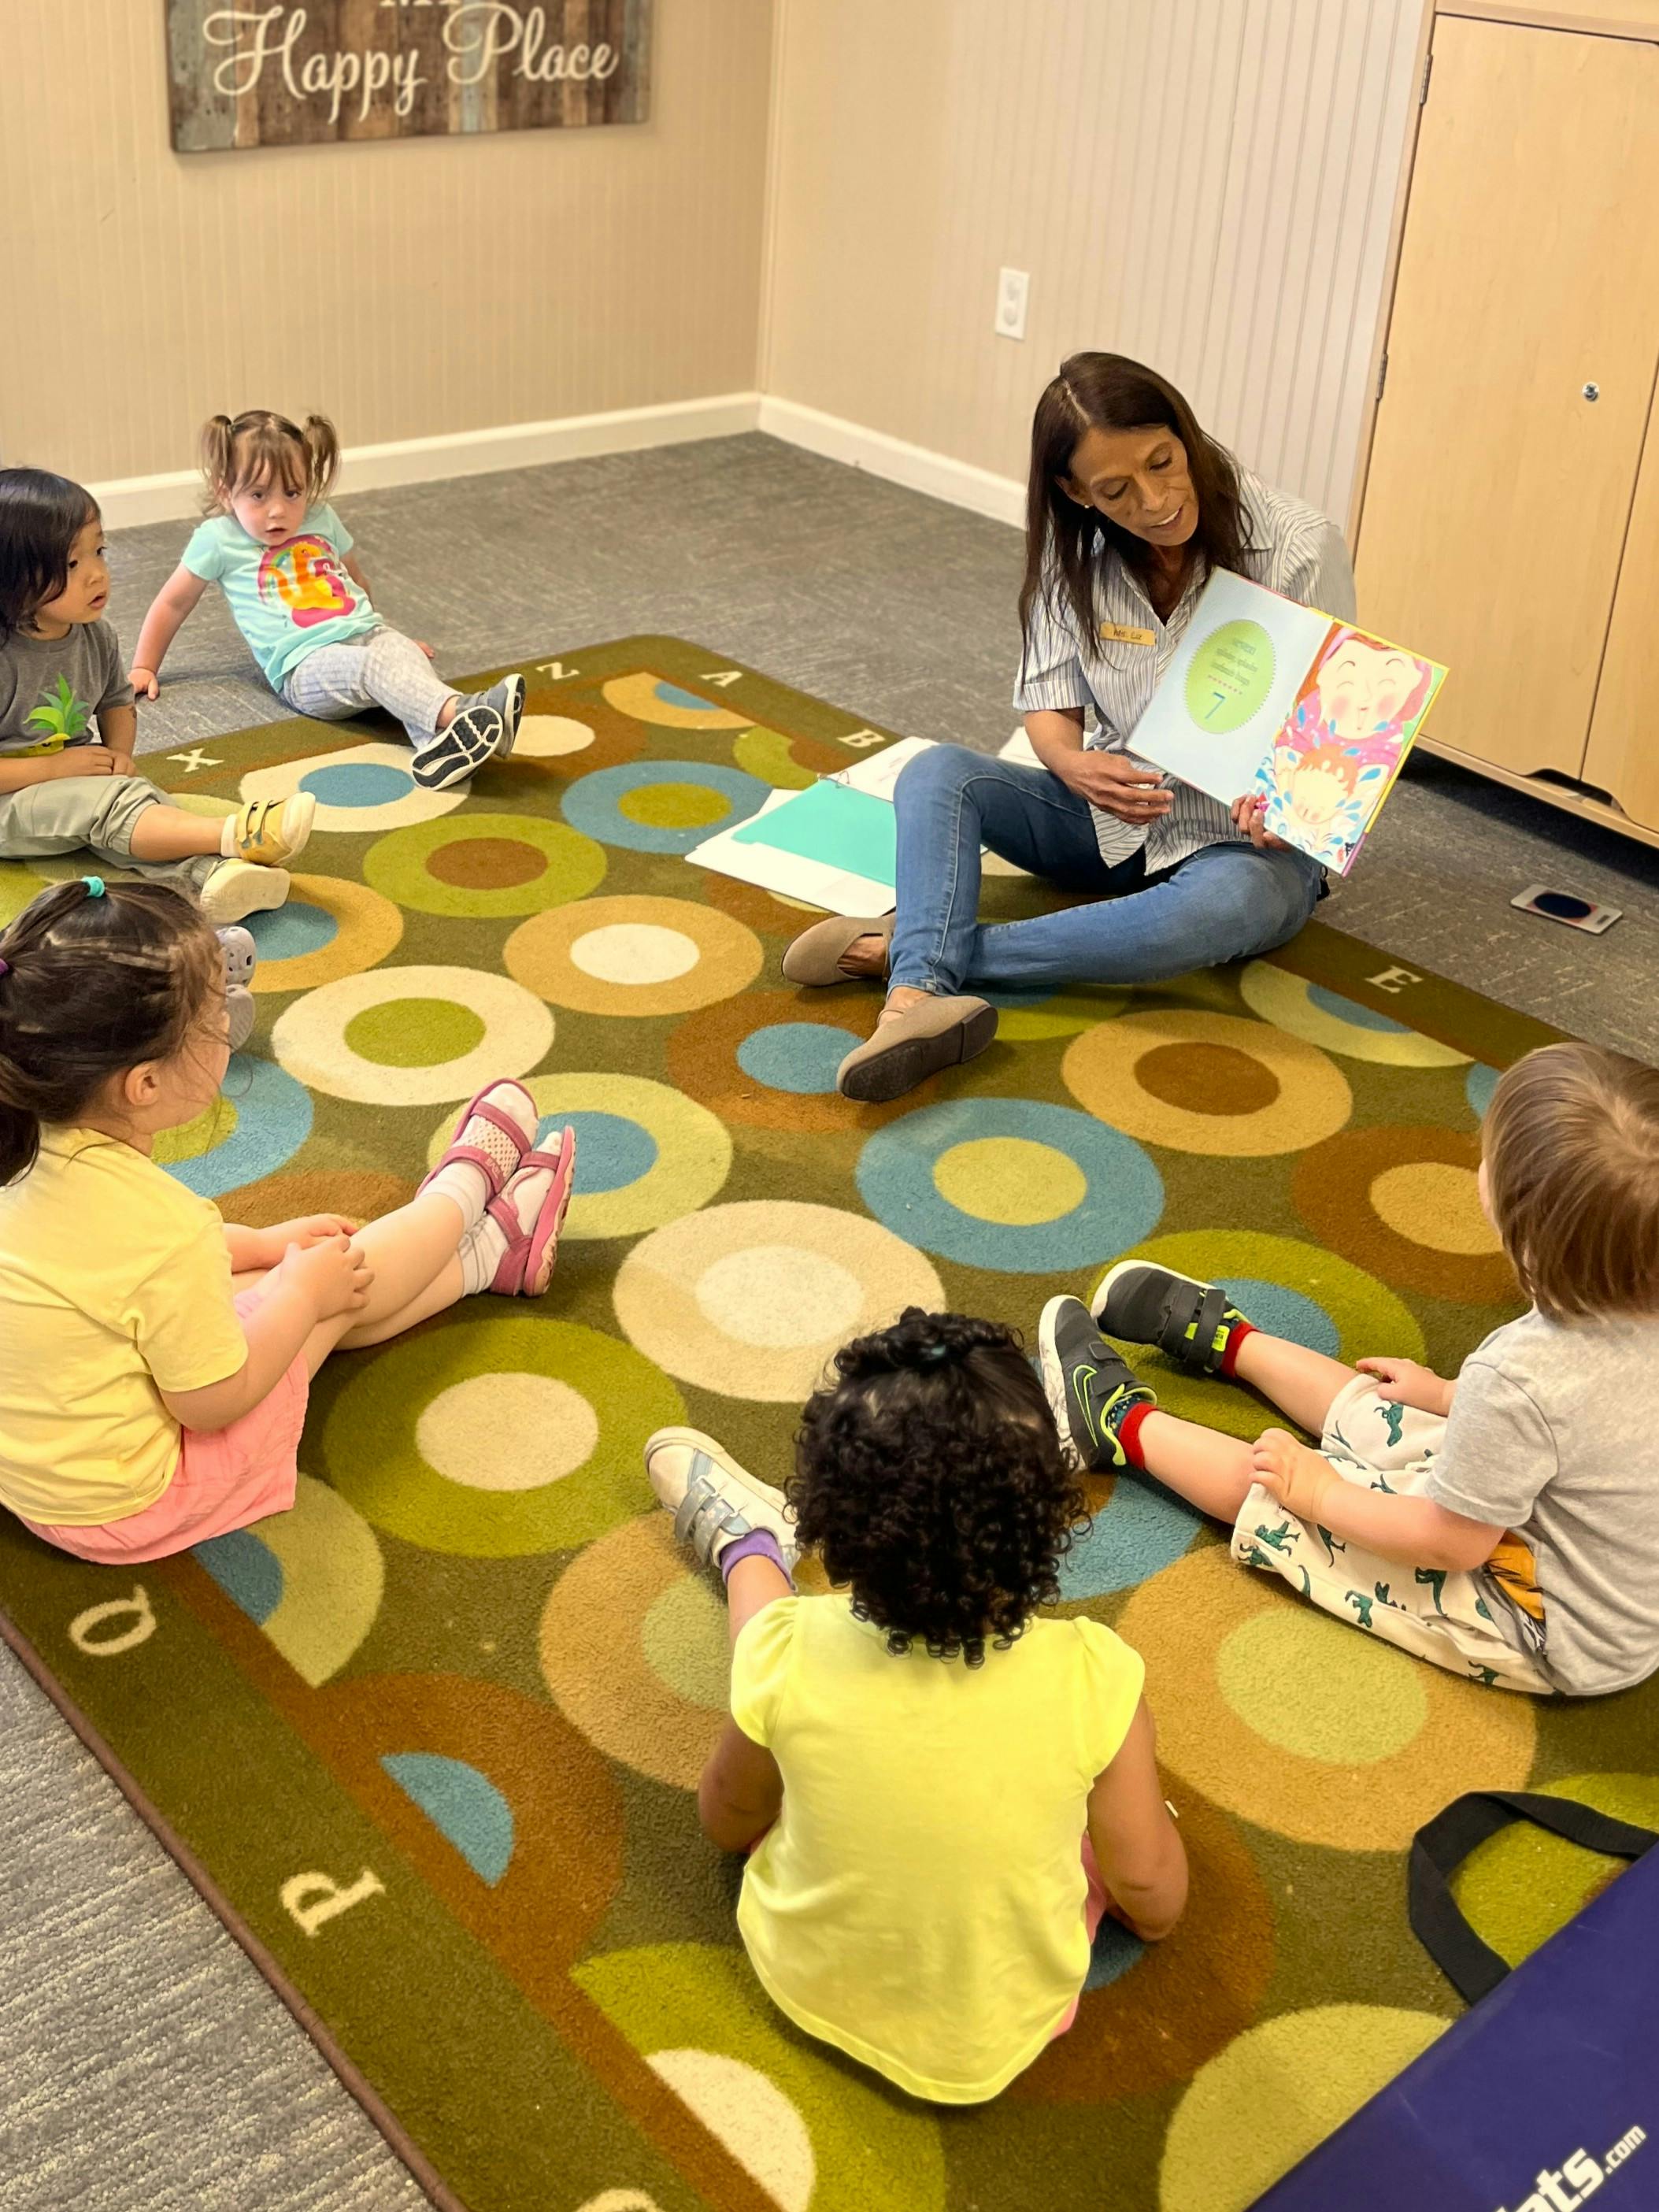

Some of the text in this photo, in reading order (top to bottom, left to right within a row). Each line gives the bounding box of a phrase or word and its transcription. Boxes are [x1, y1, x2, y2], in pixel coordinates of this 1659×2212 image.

[202, 2, 620, 124] Happy Place
[535, 662, 580, 680] Z
[698, 671, 743, 687] A
[1205, 691, 1226, 719] 7
[836, 728, 886, 748] B
[165, 747, 225, 773] X
[1363, 965, 1424, 994] E
[69, 1584, 157, 1656] Q
[280, 1866, 387, 1938] P
